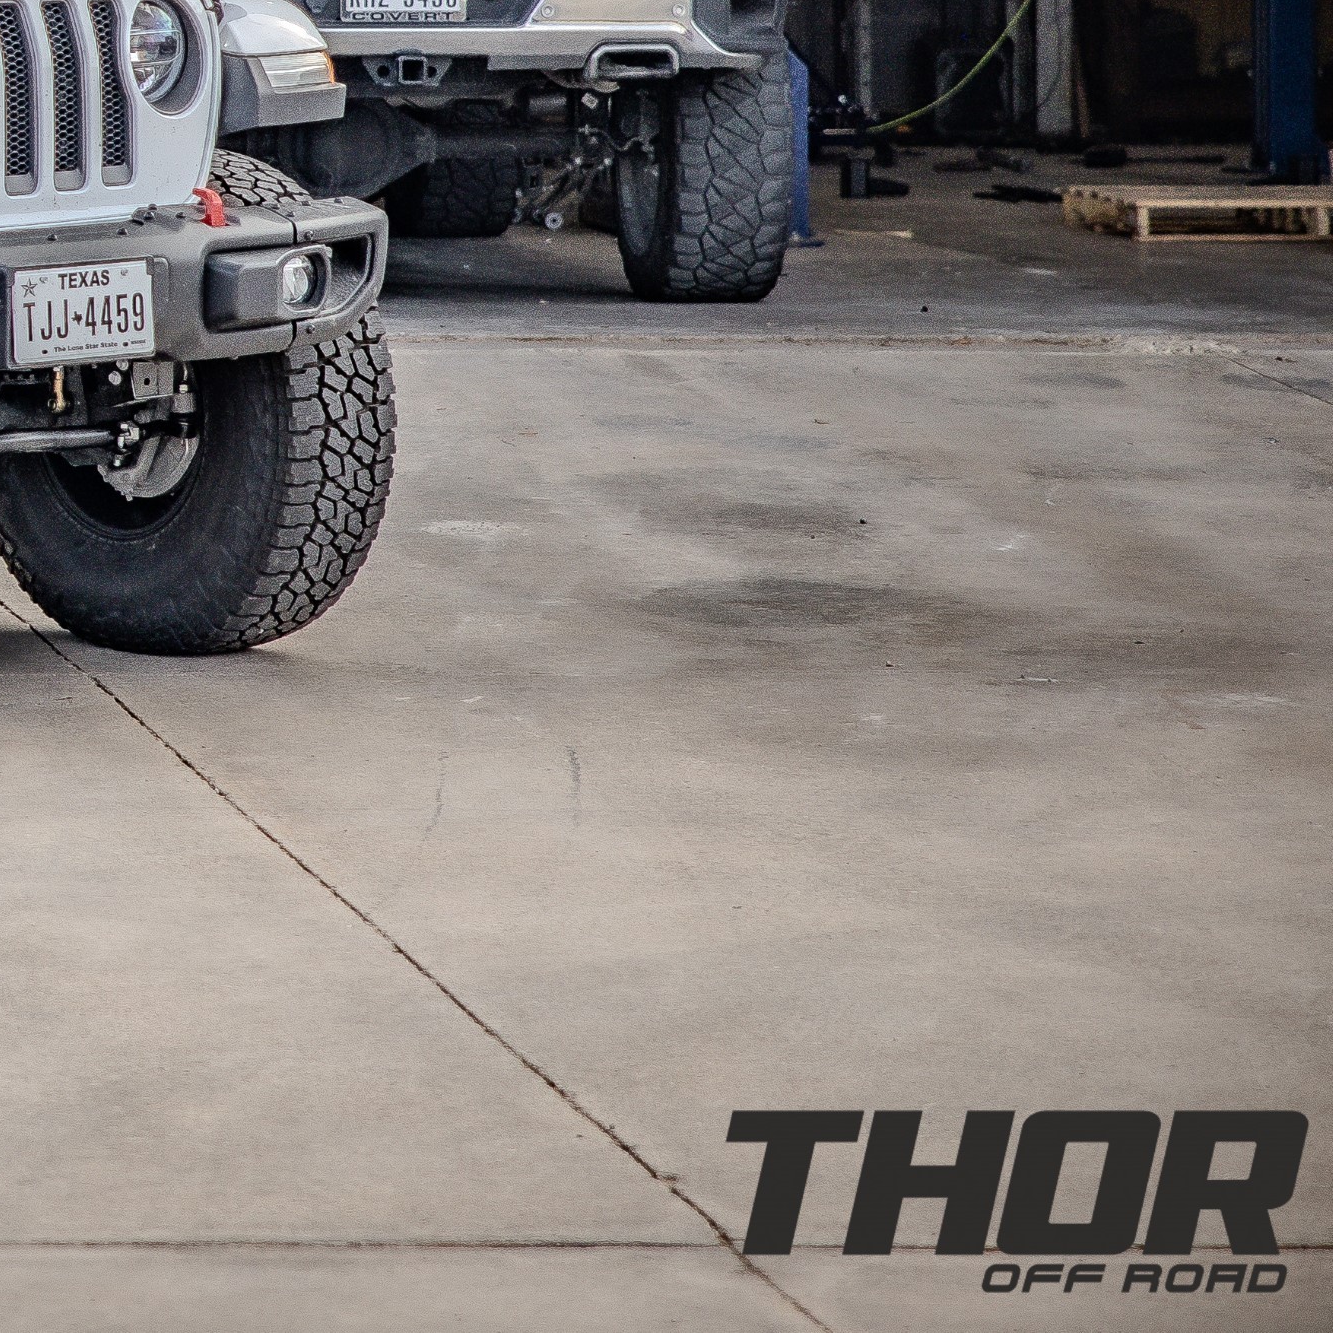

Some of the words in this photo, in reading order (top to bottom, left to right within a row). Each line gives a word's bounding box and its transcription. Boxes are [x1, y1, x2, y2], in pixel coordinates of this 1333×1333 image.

[352, 11, 454, 21] COVERT
[58, 269, 110, 290] TEXAS
[67, 344, 84, 352] Lone
[85, 341, 99, 350] Star
[100, 340, 119, 349] State
